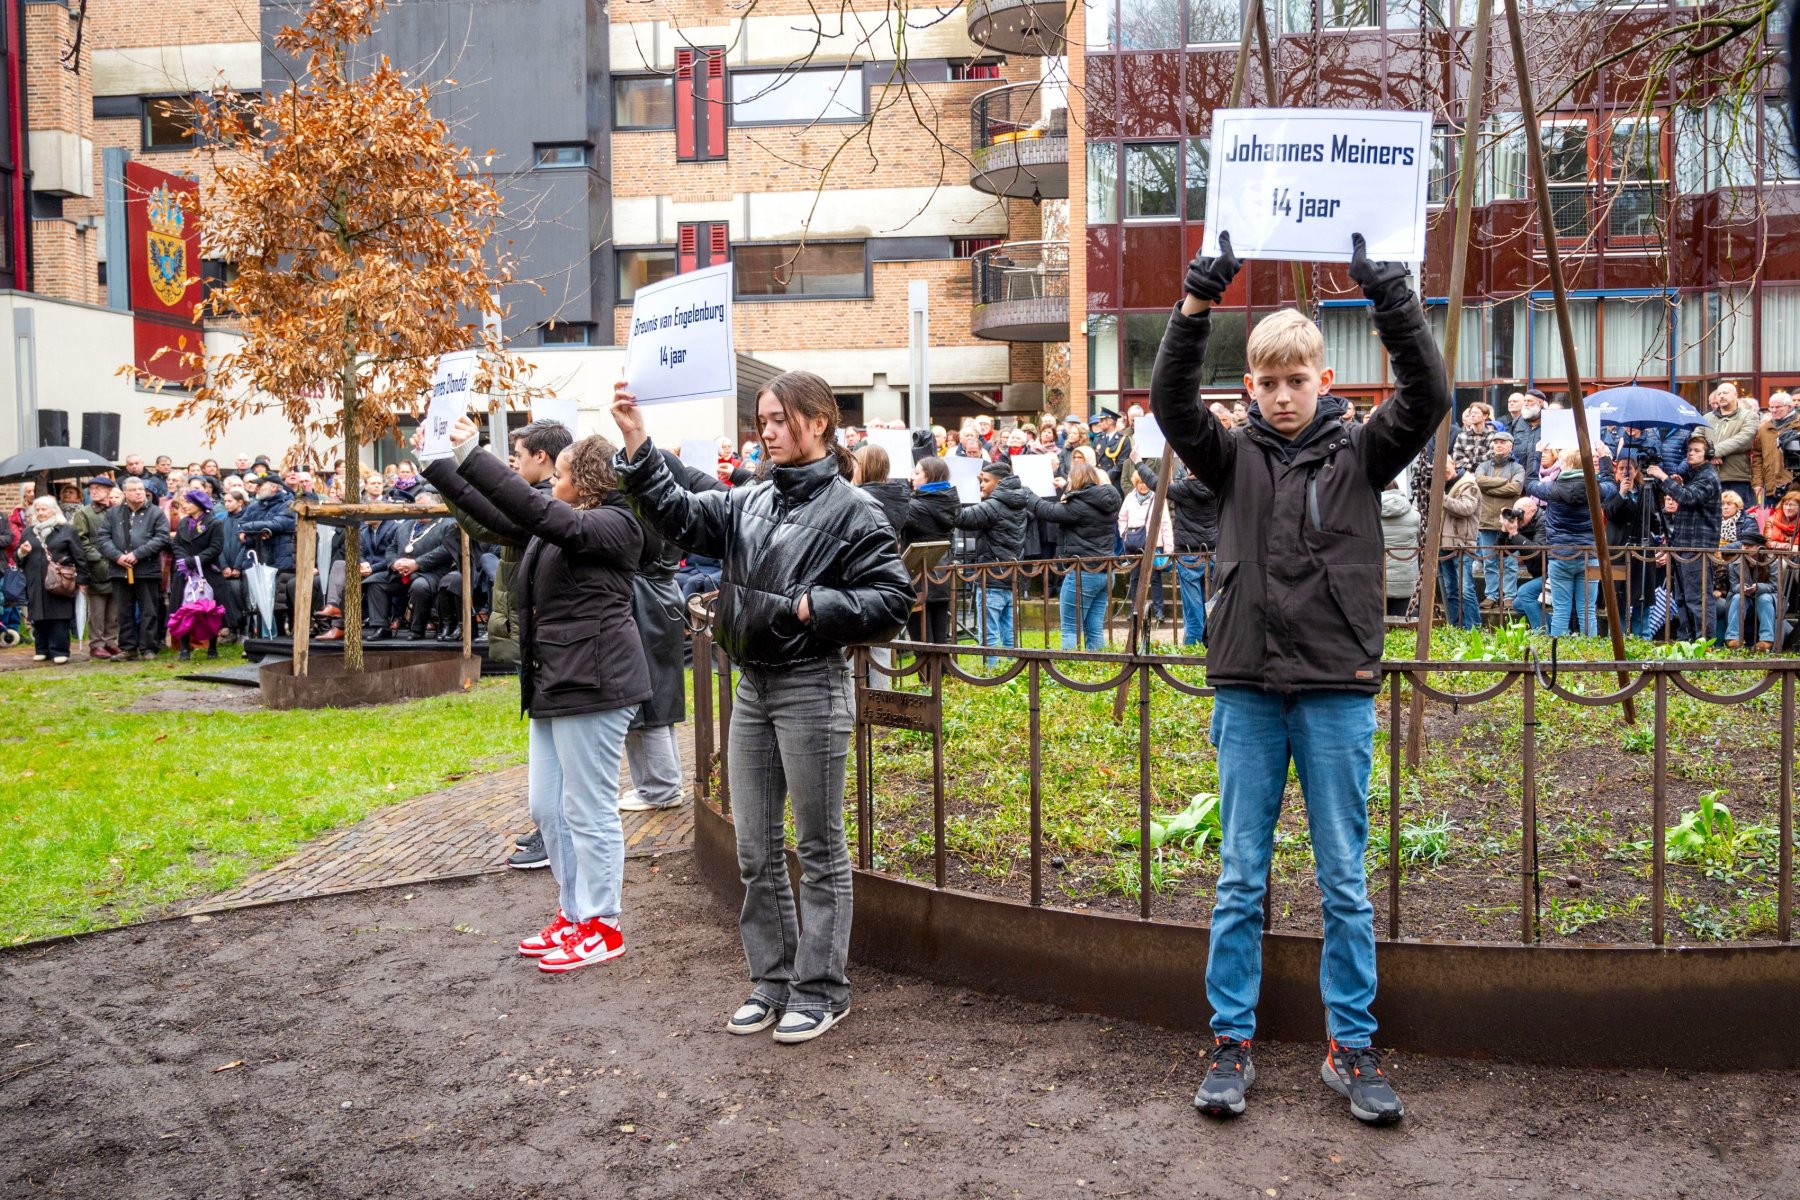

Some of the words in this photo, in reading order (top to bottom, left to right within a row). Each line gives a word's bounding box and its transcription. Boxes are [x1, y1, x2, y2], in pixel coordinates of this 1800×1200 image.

[1225, 134, 1324, 163] Johannes
[1331, 134, 1415, 166] Meiners
[1272, 188, 1291, 217] 14
[1296, 191, 1341, 224] jaar
[659, 314, 673, 330] van
[674, 300, 724, 328] Engelenburg
[660, 345, 668, 366] 14
[670, 347, 687, 368] jaar
[438, 416, 448, 440] jaar
